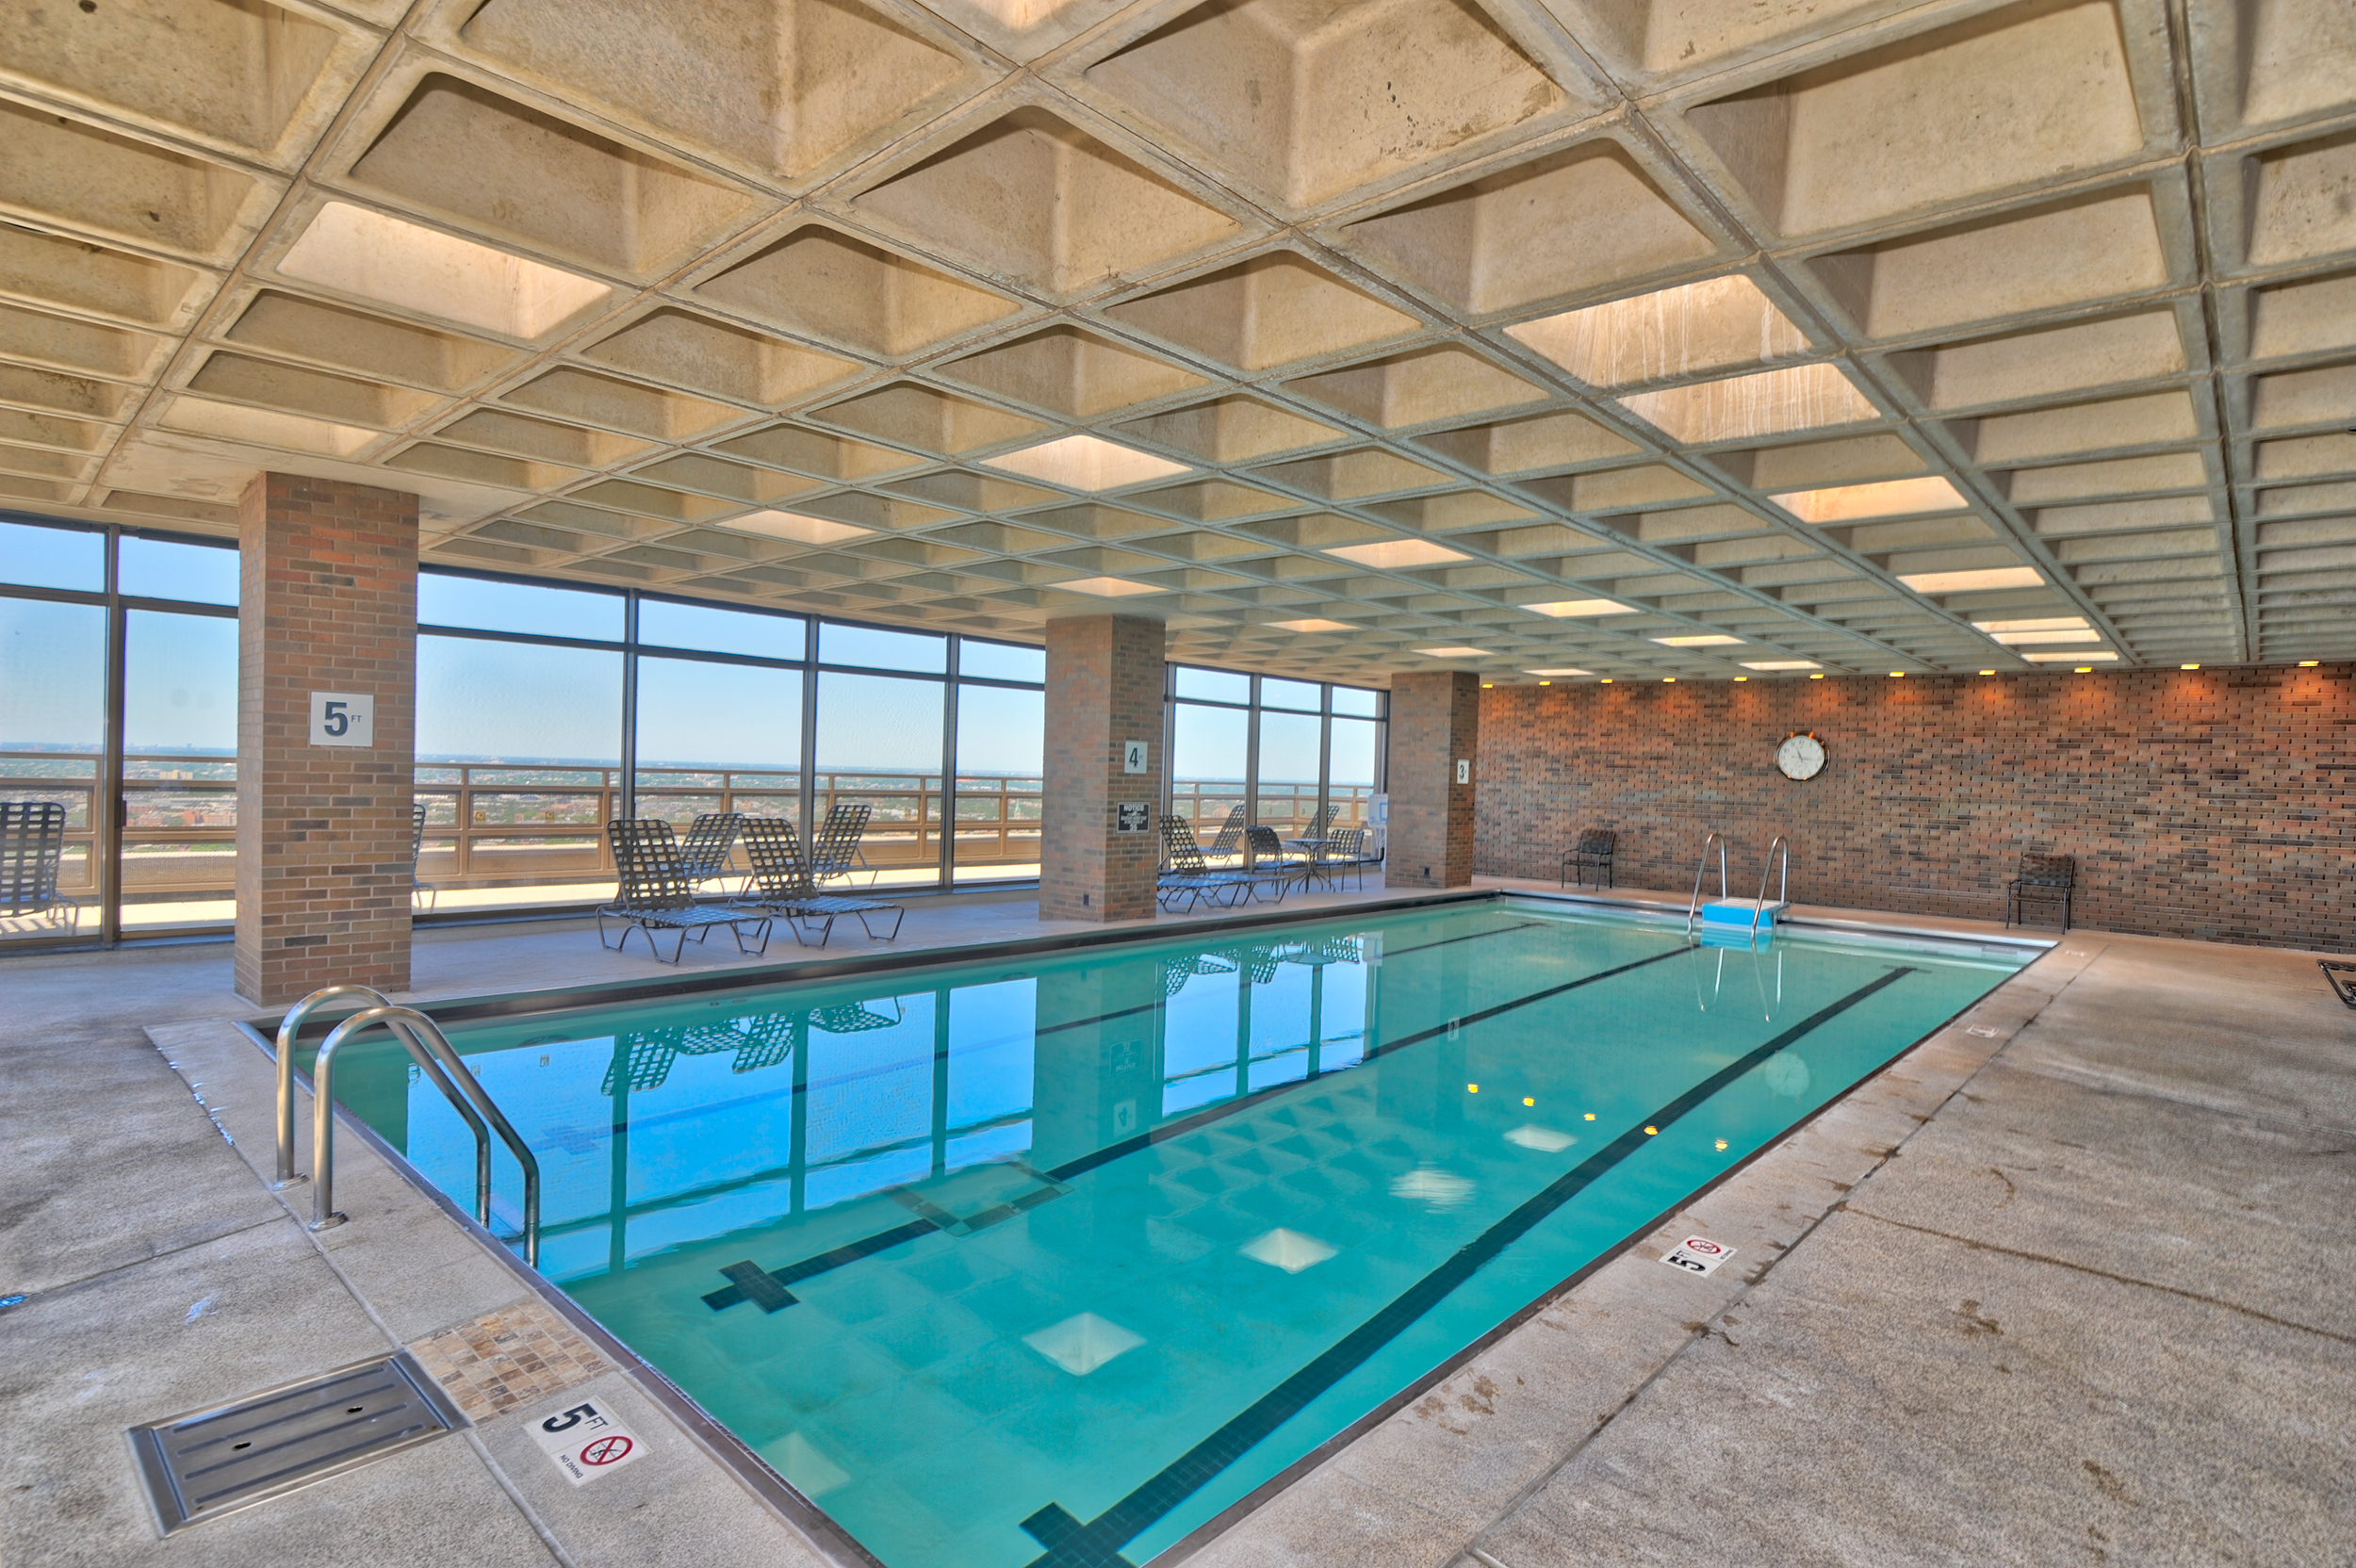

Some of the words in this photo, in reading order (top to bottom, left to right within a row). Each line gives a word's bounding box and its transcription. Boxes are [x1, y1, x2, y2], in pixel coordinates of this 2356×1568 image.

[324, 701, 348, 737] 5
[351, 714, 362, 723] FT
[1128, 746, 1138, 768] 4
[1459, 764, 1464, 780] 3
[1667, 1255, 1706, 1271] 5
[542, 1403, 598, 1433] 5
[584, 1416, 609, 1430] FT
[559, 1454, 570, 1463] NO
[565, 1462, 583, 1479] DIVING
